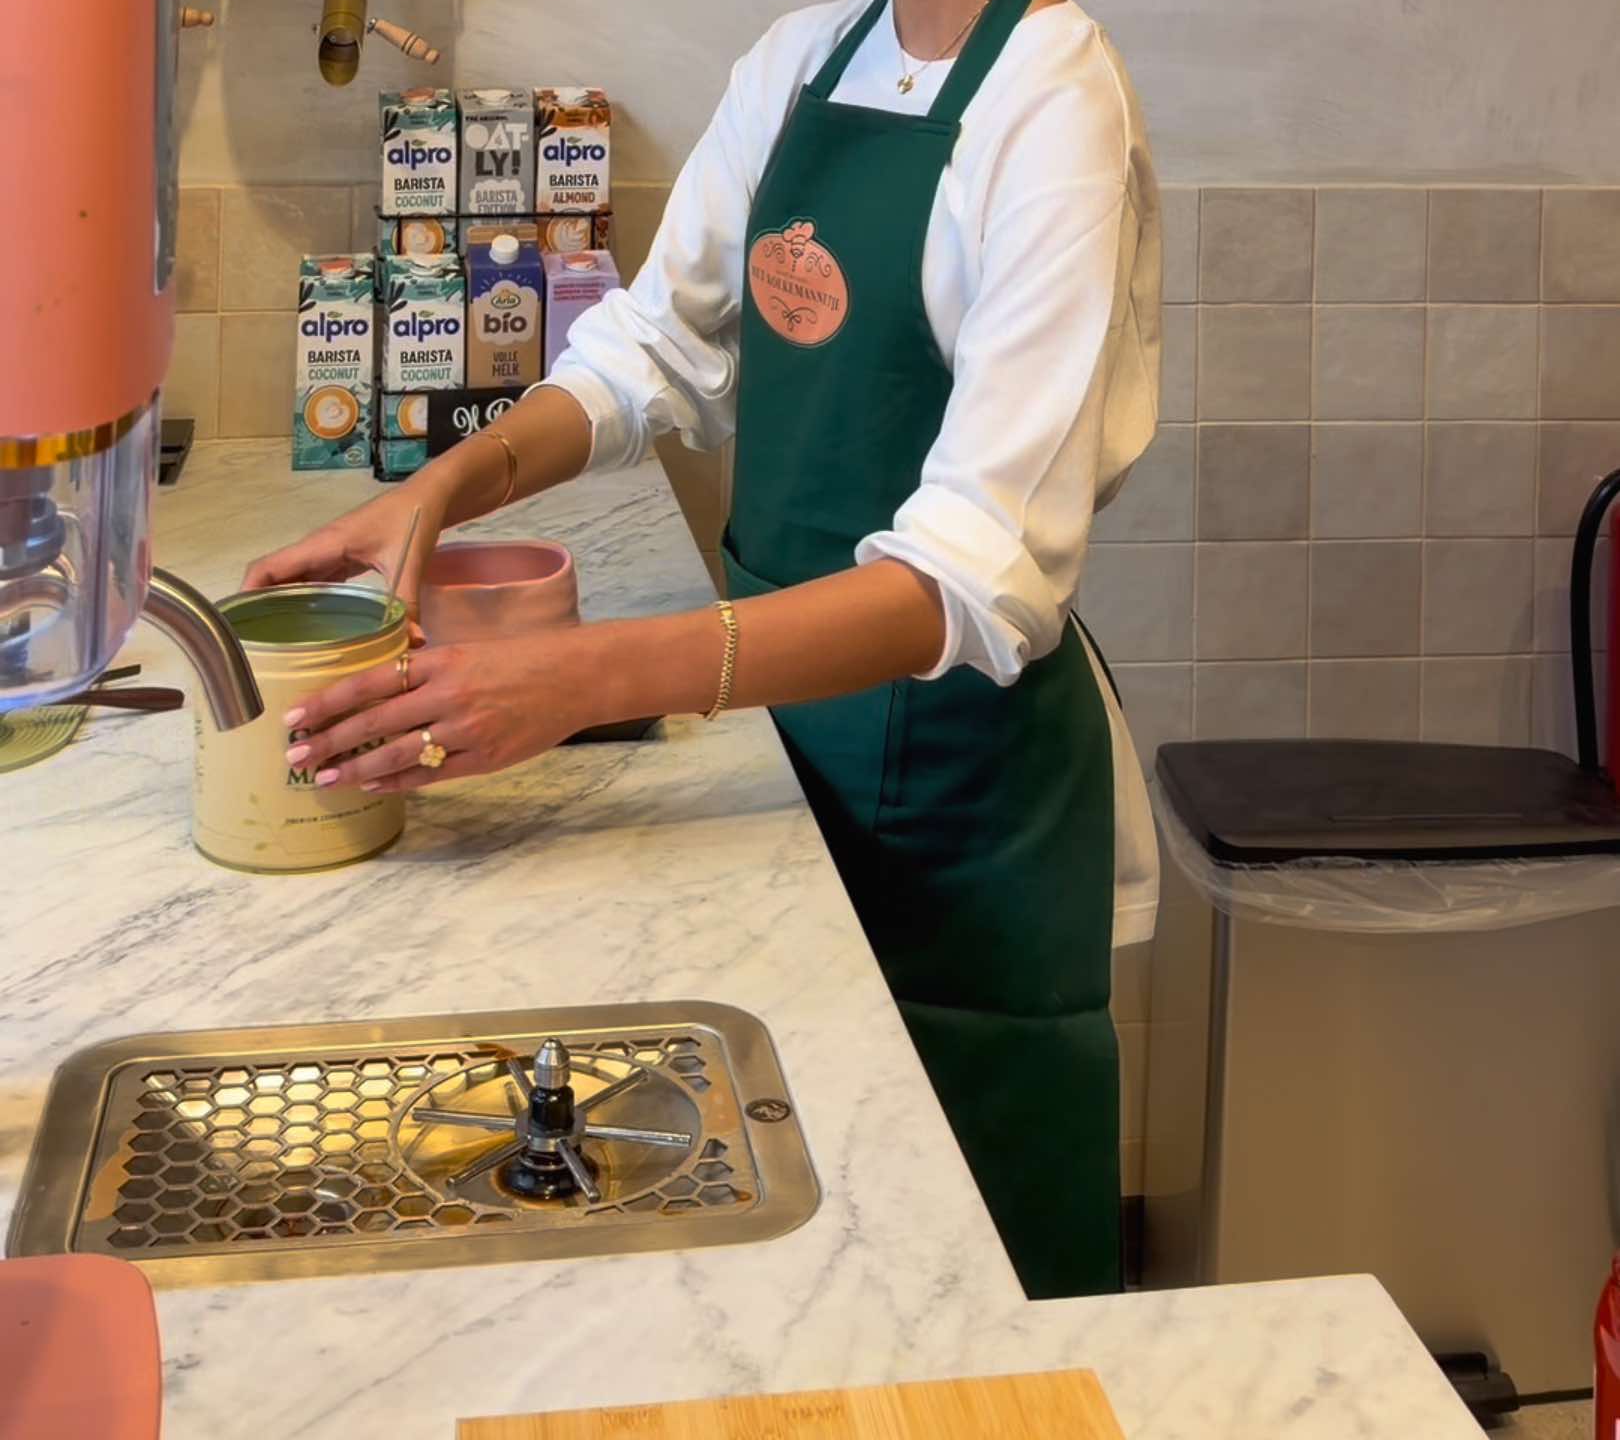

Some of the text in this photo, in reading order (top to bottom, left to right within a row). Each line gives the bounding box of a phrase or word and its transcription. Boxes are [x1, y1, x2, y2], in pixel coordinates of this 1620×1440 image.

[465, 123, 529, 150] OAT-
[388, 140, 452, 170] alpro
[543, 137, 605, 167] alpro
[475, 150, 521, 177] LY!
[394, 176, 445, 191] BARISTA
[550, 174, 599, 187] BARISTA
[395, 194, 444, 207] COCONUT
[476, 190, 517, 203] BARISTA
[553, 191, 595, 203] ALMOND
[301, 312, 368, 343] alpro
[393, 312, 460, 343] alpro
[308, 349, 360, 364] BARISTA
[400, 349, 453, 364] BARISTA
[308, 367, 360, 380] COCONUT
[401, 367, 452, 381] COCONUT
[492, 363, 519, 377] MELK
